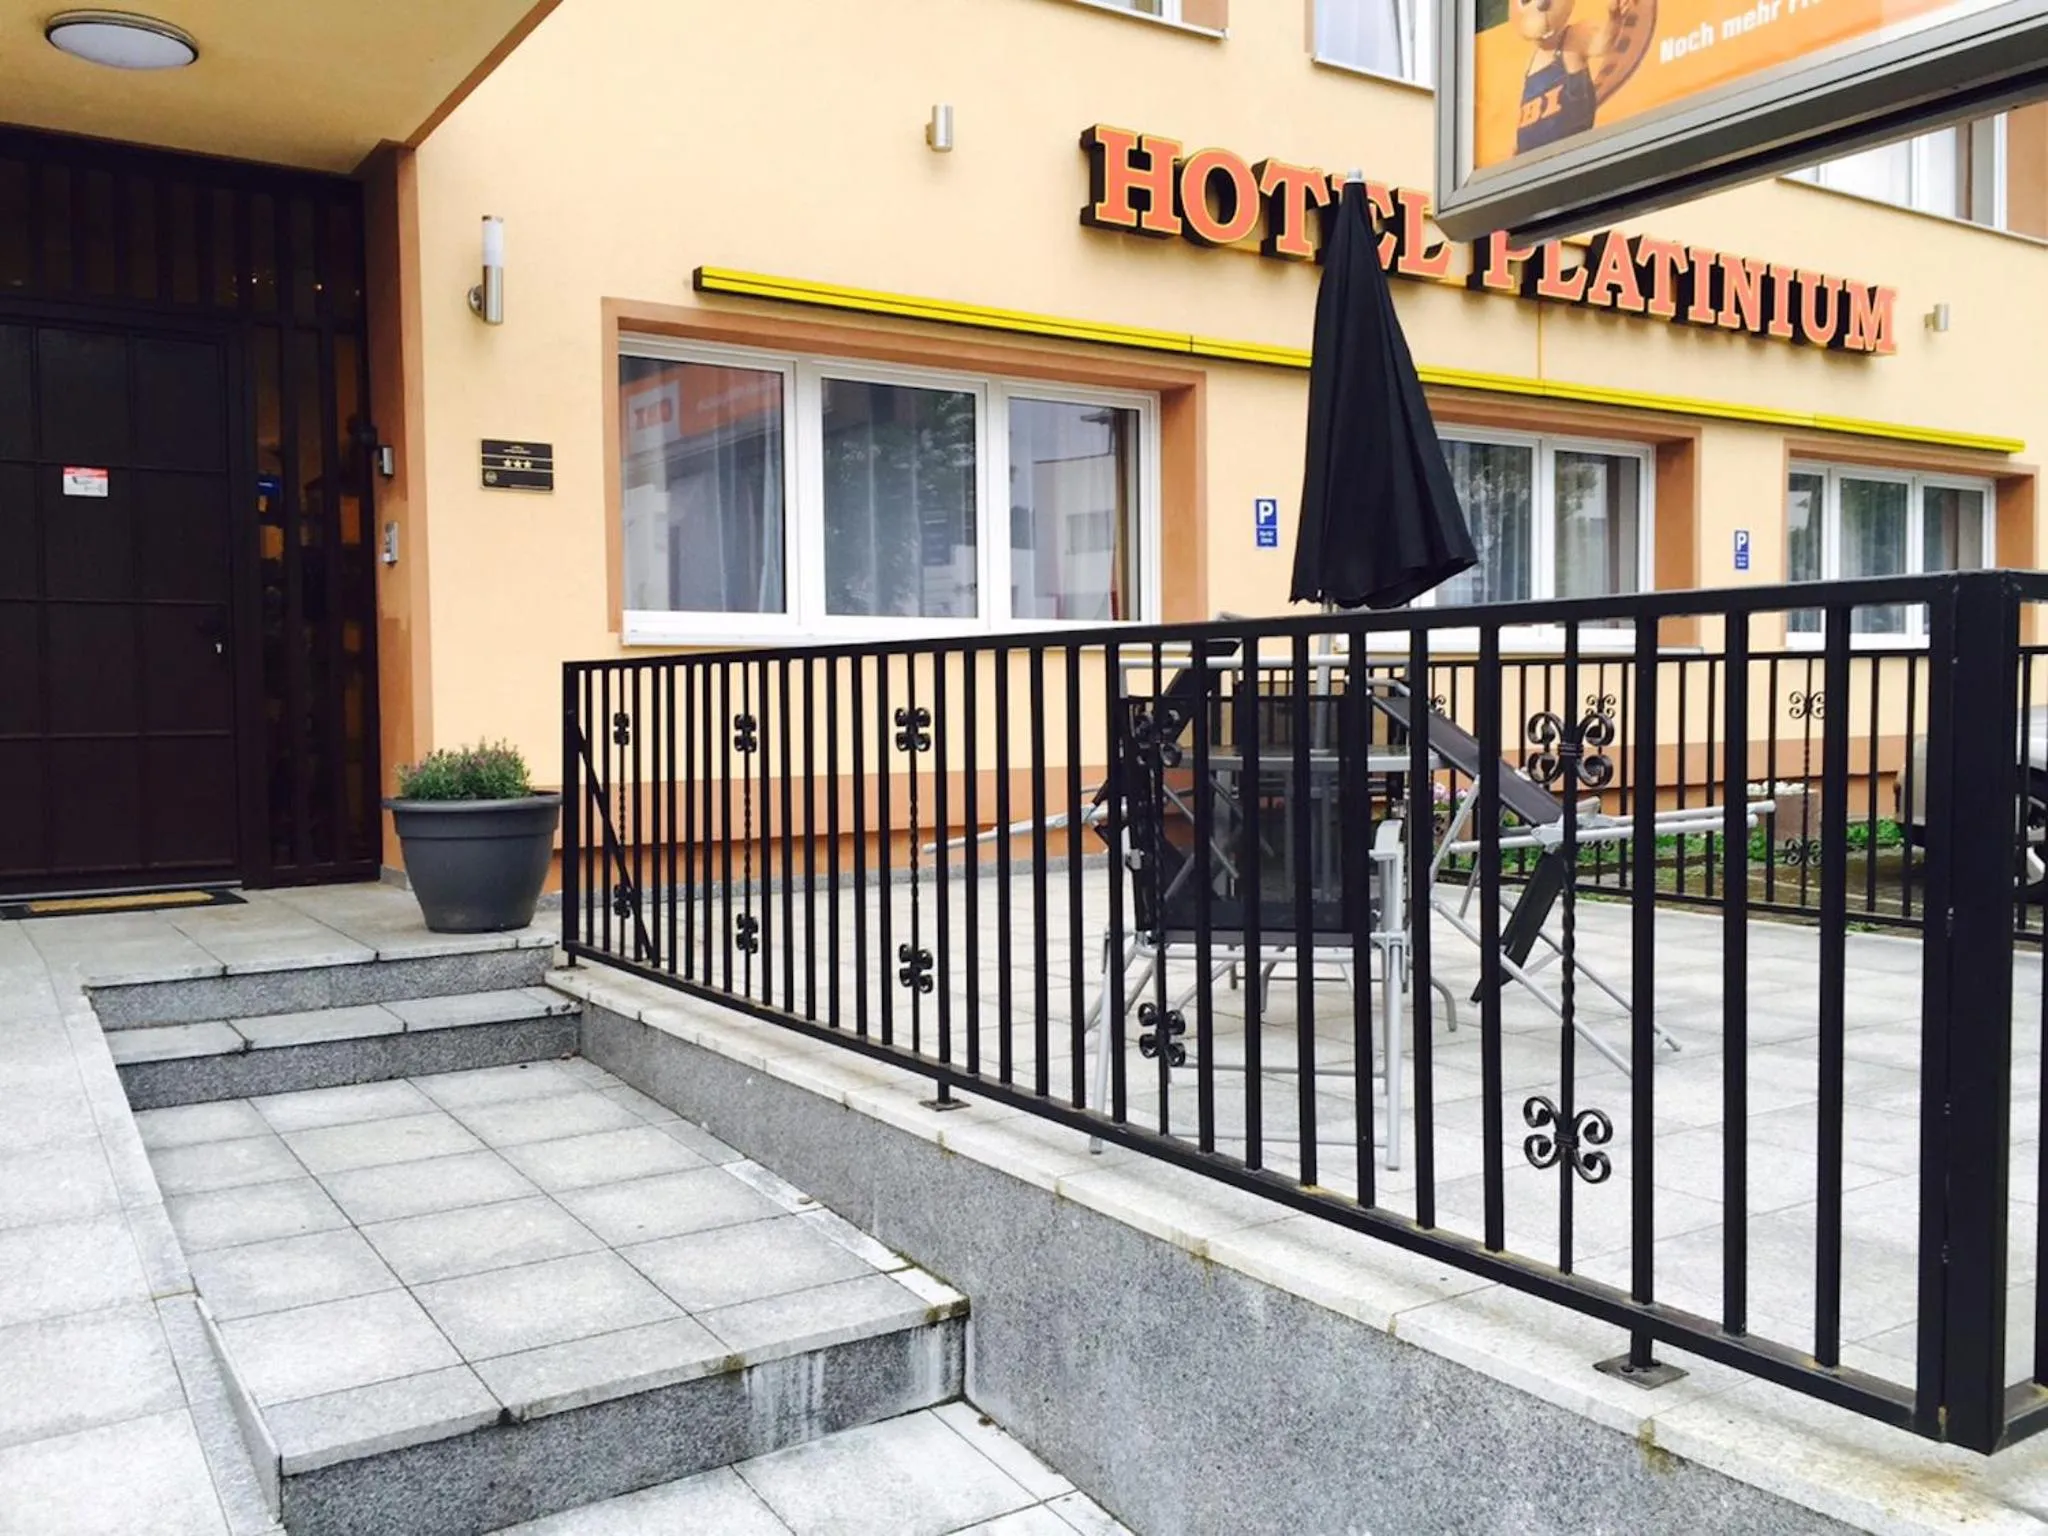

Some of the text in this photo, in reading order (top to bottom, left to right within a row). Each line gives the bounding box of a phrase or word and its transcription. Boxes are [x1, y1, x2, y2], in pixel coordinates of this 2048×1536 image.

[1660, 0, 1782, 64] Noch mehr
[1482, 229, 1898, 353] PLATINIUM
[1258, 501, 1274, 525] P
[1737, 532, 1747, 551] P
